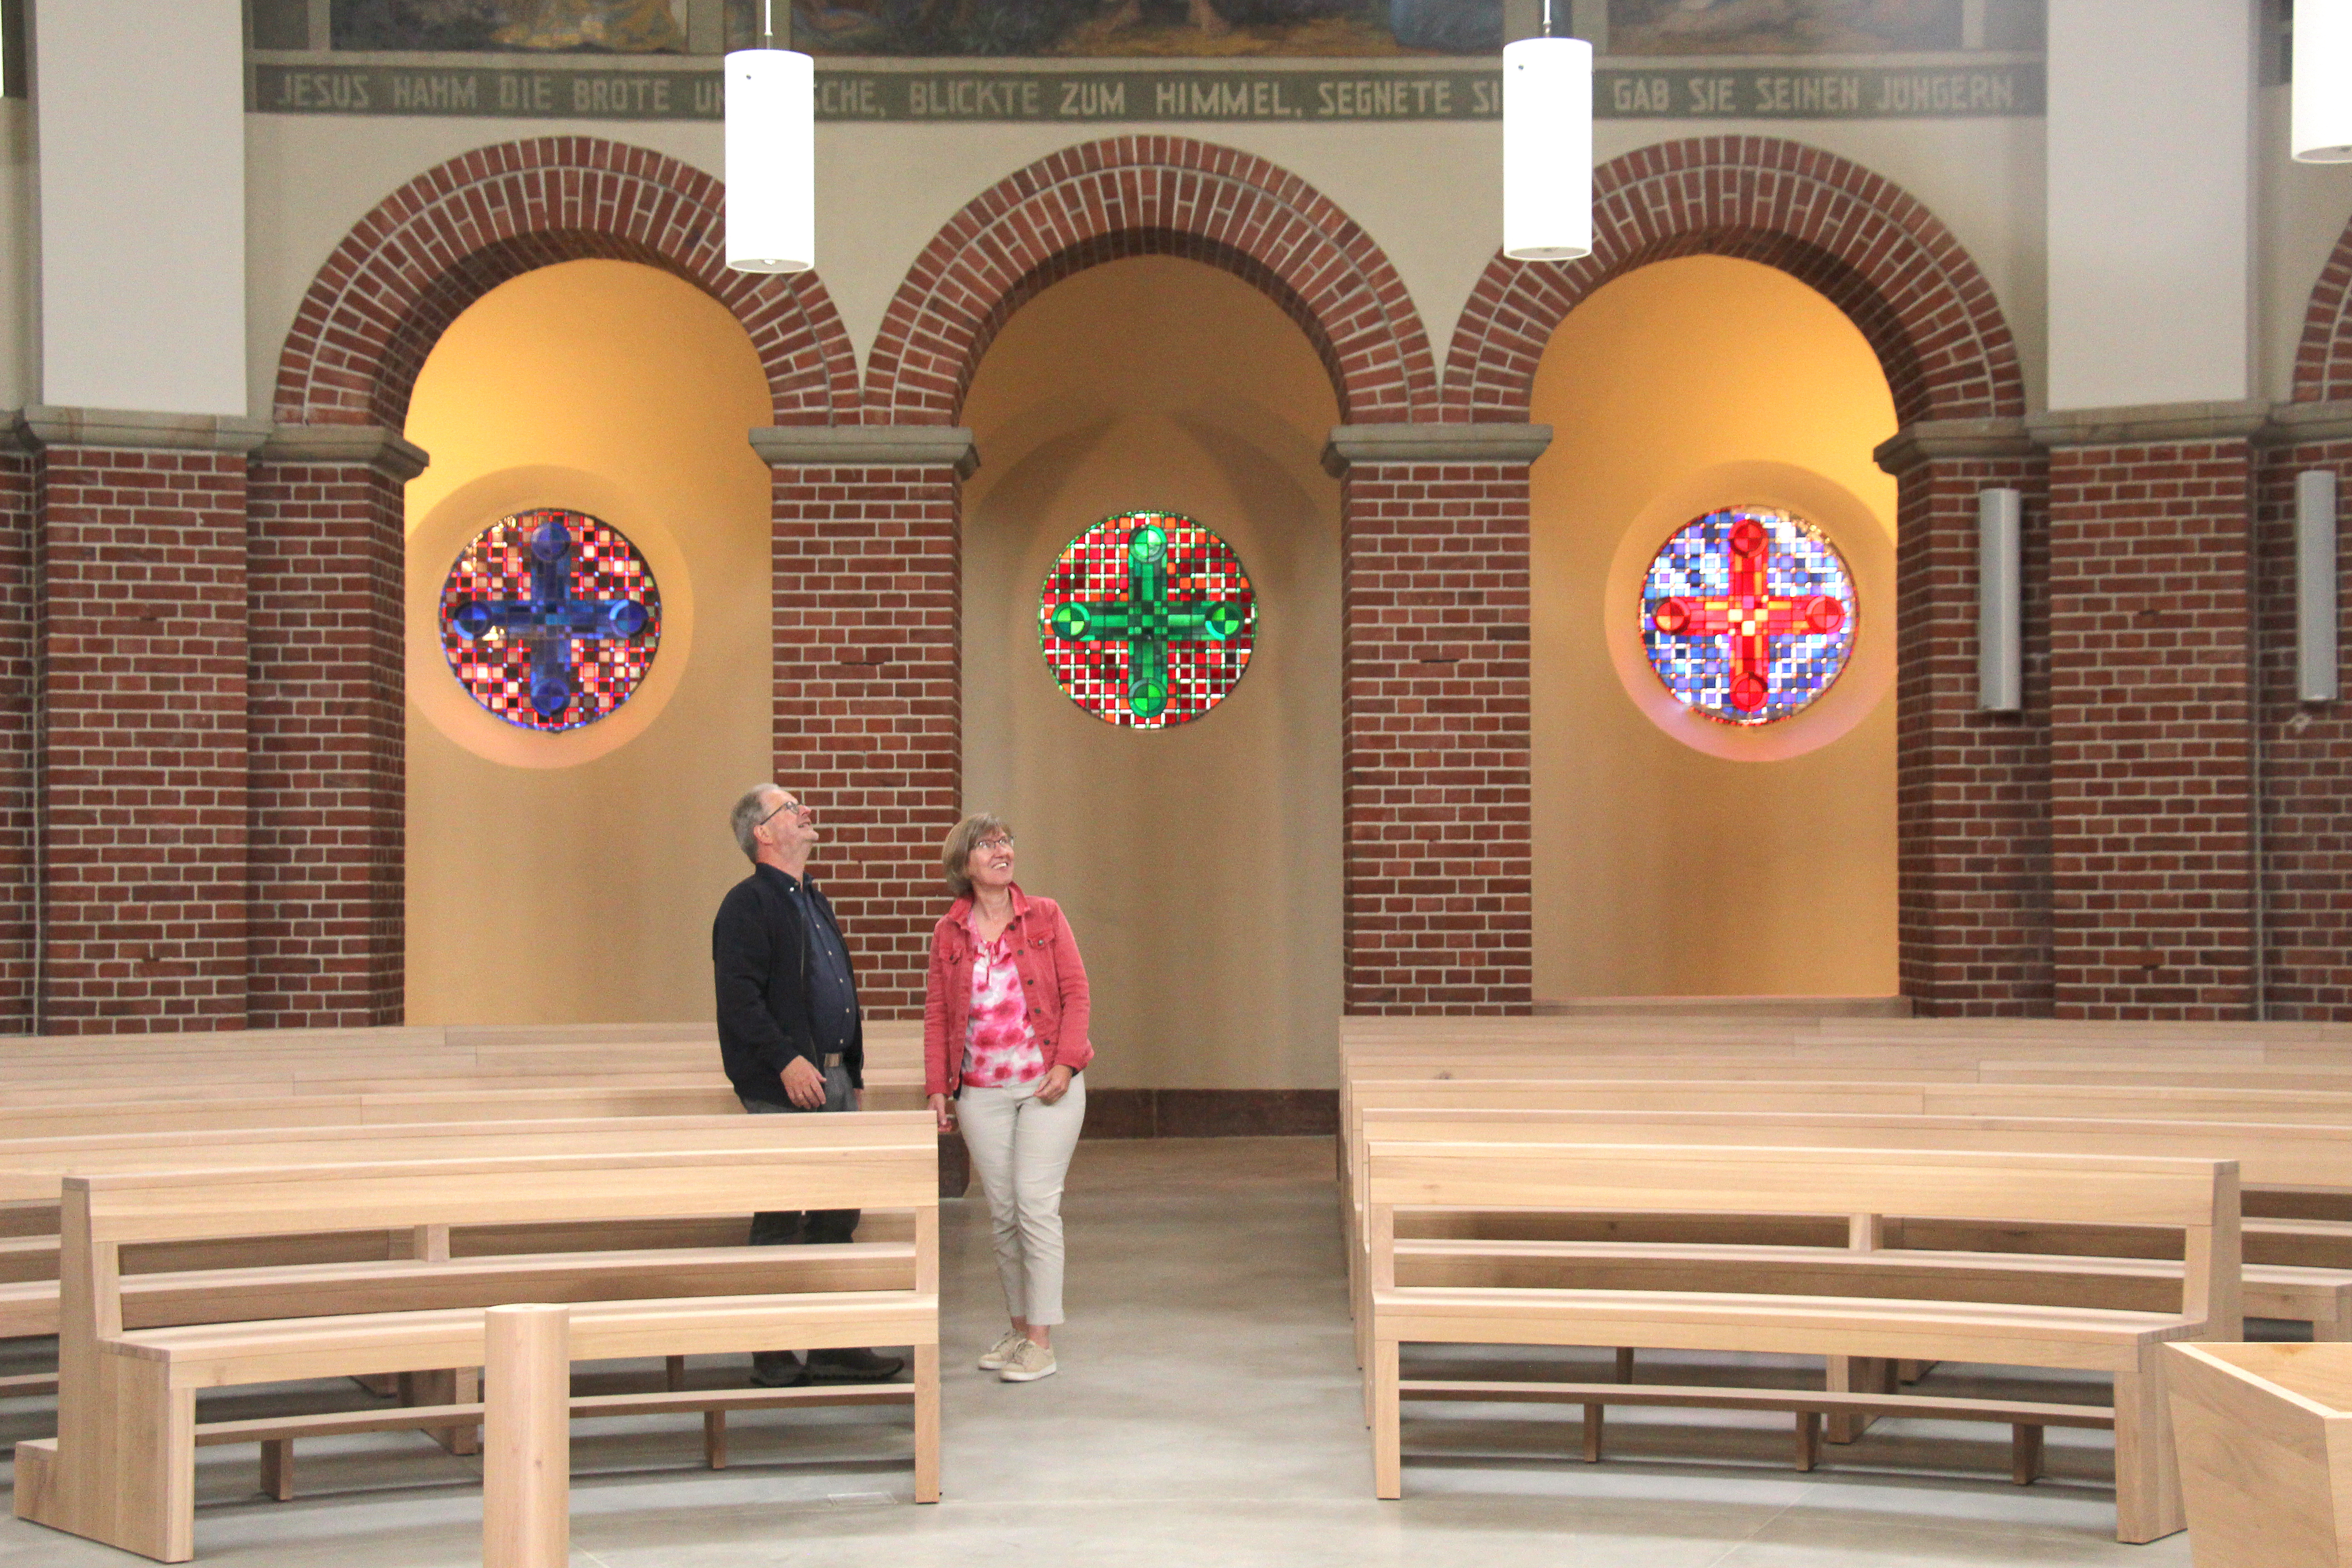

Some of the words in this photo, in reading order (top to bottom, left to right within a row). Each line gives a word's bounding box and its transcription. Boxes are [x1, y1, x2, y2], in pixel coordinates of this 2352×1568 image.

[276, 73, 370, 108] JESUS
[500, 75, 552, 110] DIE
[573, 78, 671, 112] BROTE
[909, 80, 1040, 115] BLICKTE
[1059, 81, 1125, 115] ZUM
[1318, 80, 1451, 115] SEGNETE
[1613, 77, 1670, 112] GAB
[1688, 77, 1737, 111] SIE
[1755, 77, 1859, 112] SEINEN
